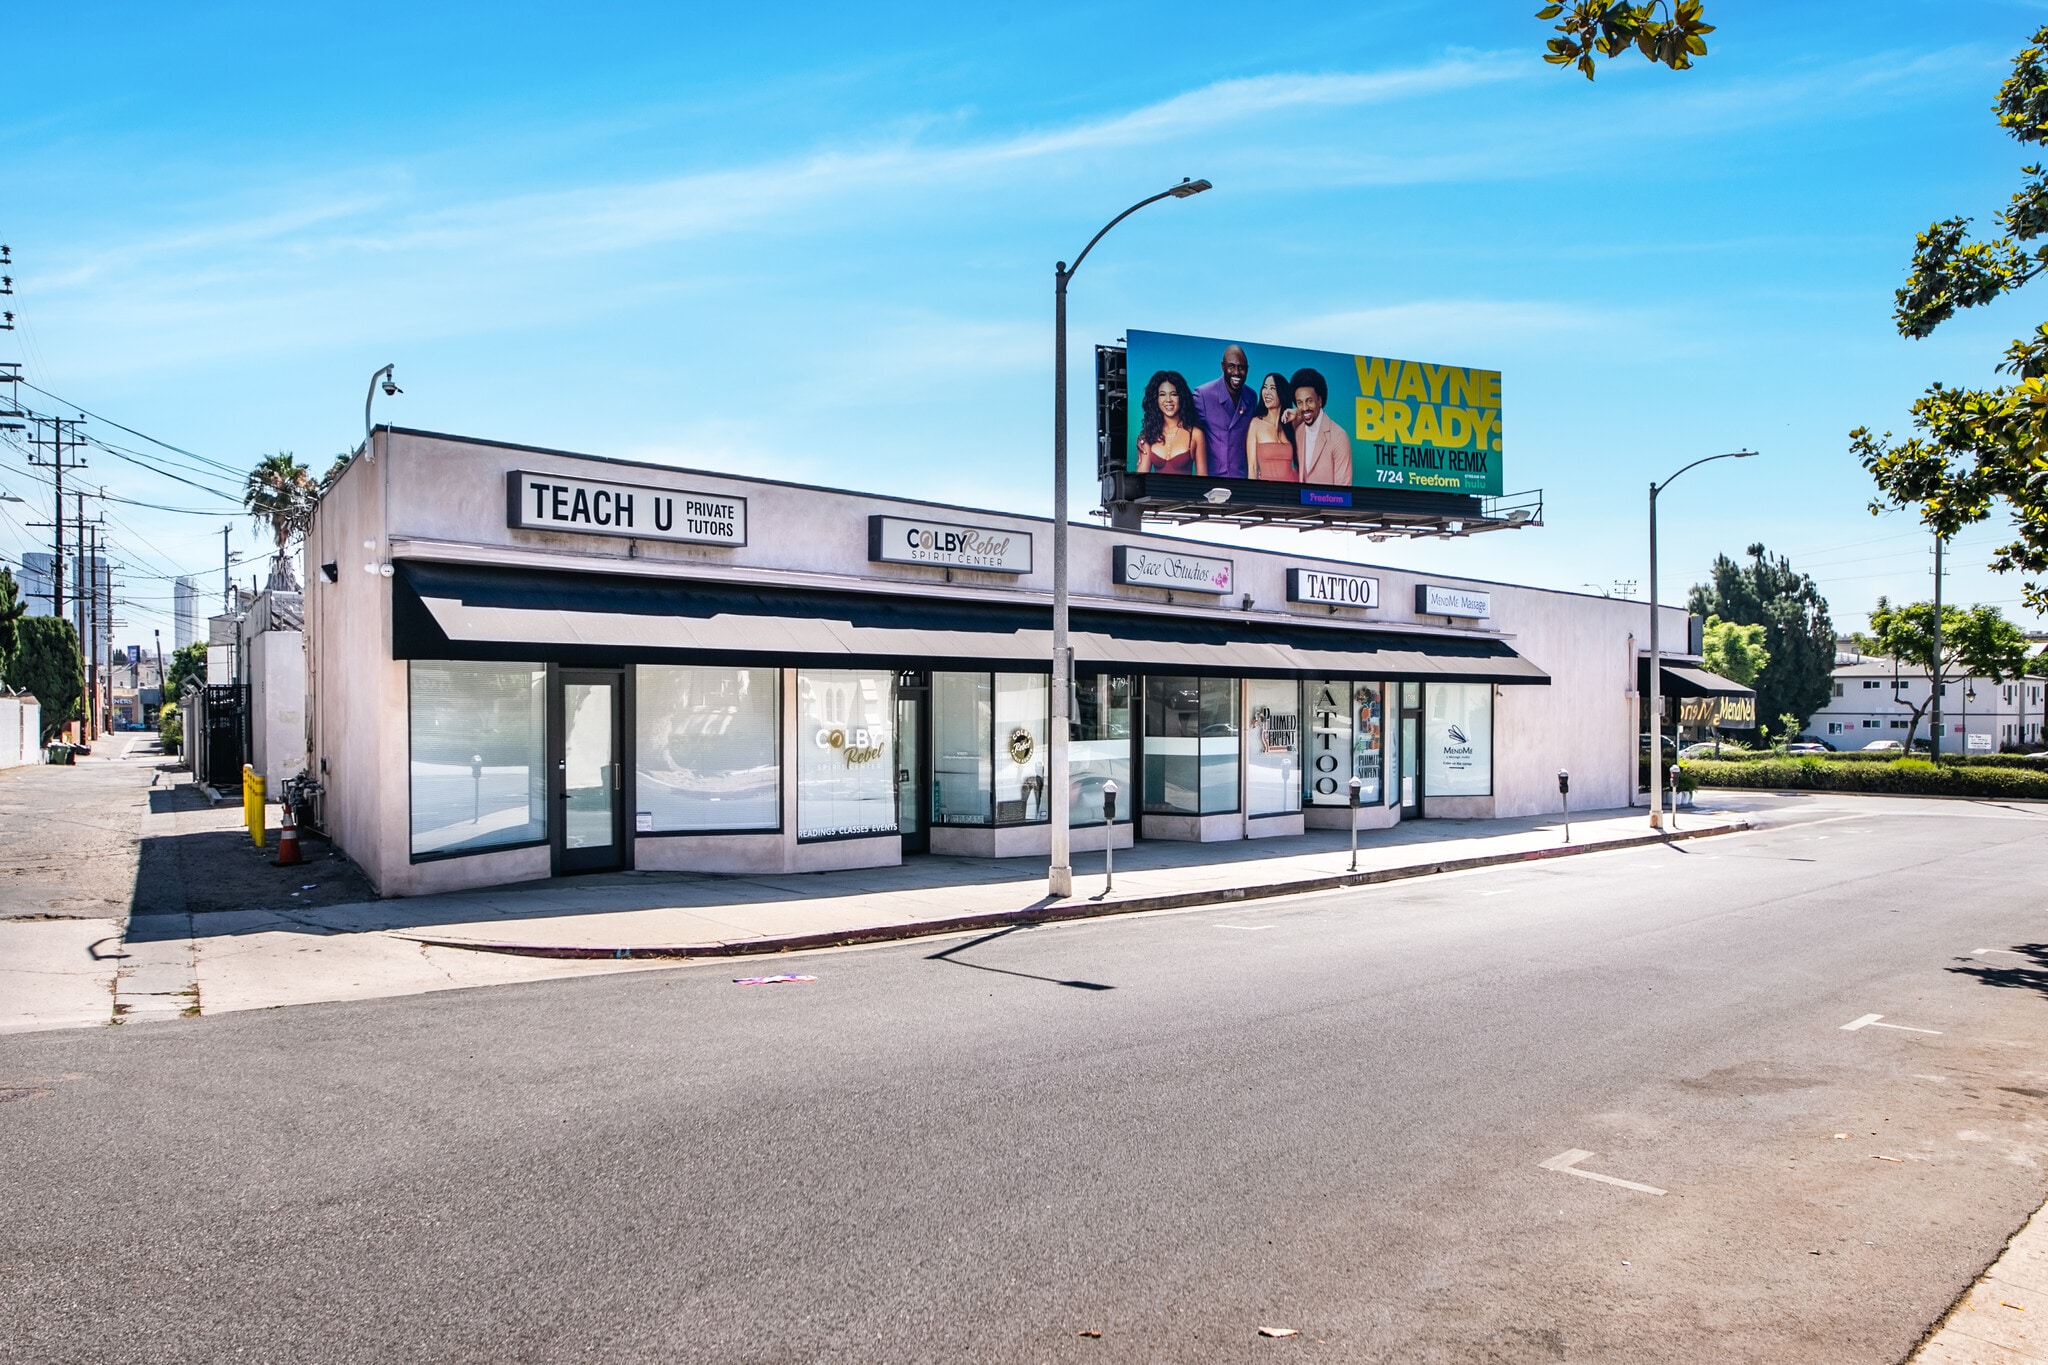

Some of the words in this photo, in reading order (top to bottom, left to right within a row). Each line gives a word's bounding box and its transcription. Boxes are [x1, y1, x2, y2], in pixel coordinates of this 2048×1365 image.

[1354, 355, 1502, 409] WAYNE
[1355, 397, 1503, 452] BRADY:
[1373, 443, 1399, 466] THE
[1402, 446, 1446, 470] FAMILY
[1449, 451, 1488, 473] REMIX
[1376, 469, 1404, 484] 7/24
[1408, 471, 1461, 488] Freeform
[1465, 479, 1486, 489] hulu
[530, 482, 634, 528] TEACH
[655, 497, 673, 532] U
[1309, 492, 1344, 504] Freeform
[686, 500, 735, 520] PRIVATE
[687, 519, 734, 537] TUTORS
[907, 528, 968, 553] COLBY
[962, 529, 1011, 557] Rebel
[912, 550, 952, 562] SPIRIT
[958, 554, 1003, 567] CENTER
[1126, 554, 1162, 581] Jace
[1164, 557, 1210, 582] Studios
[1307, 574, 1371, 604] TATTOO
[1461, 596, 1487, 613] Massage
[1263, 707, 1297, 730] PLUMED
[815, 729, 883, 749] COLBY
[1012, 728, 1032, 741] COLBY
[1315, 681, 1338, 795] ATTOO
[844, 742, 884, 769] Rebel
[798, 828, 836, 839] READINGS
[839, 824, 869, 834] CLASSES
[872, 822, 898, 832] EVENTS
